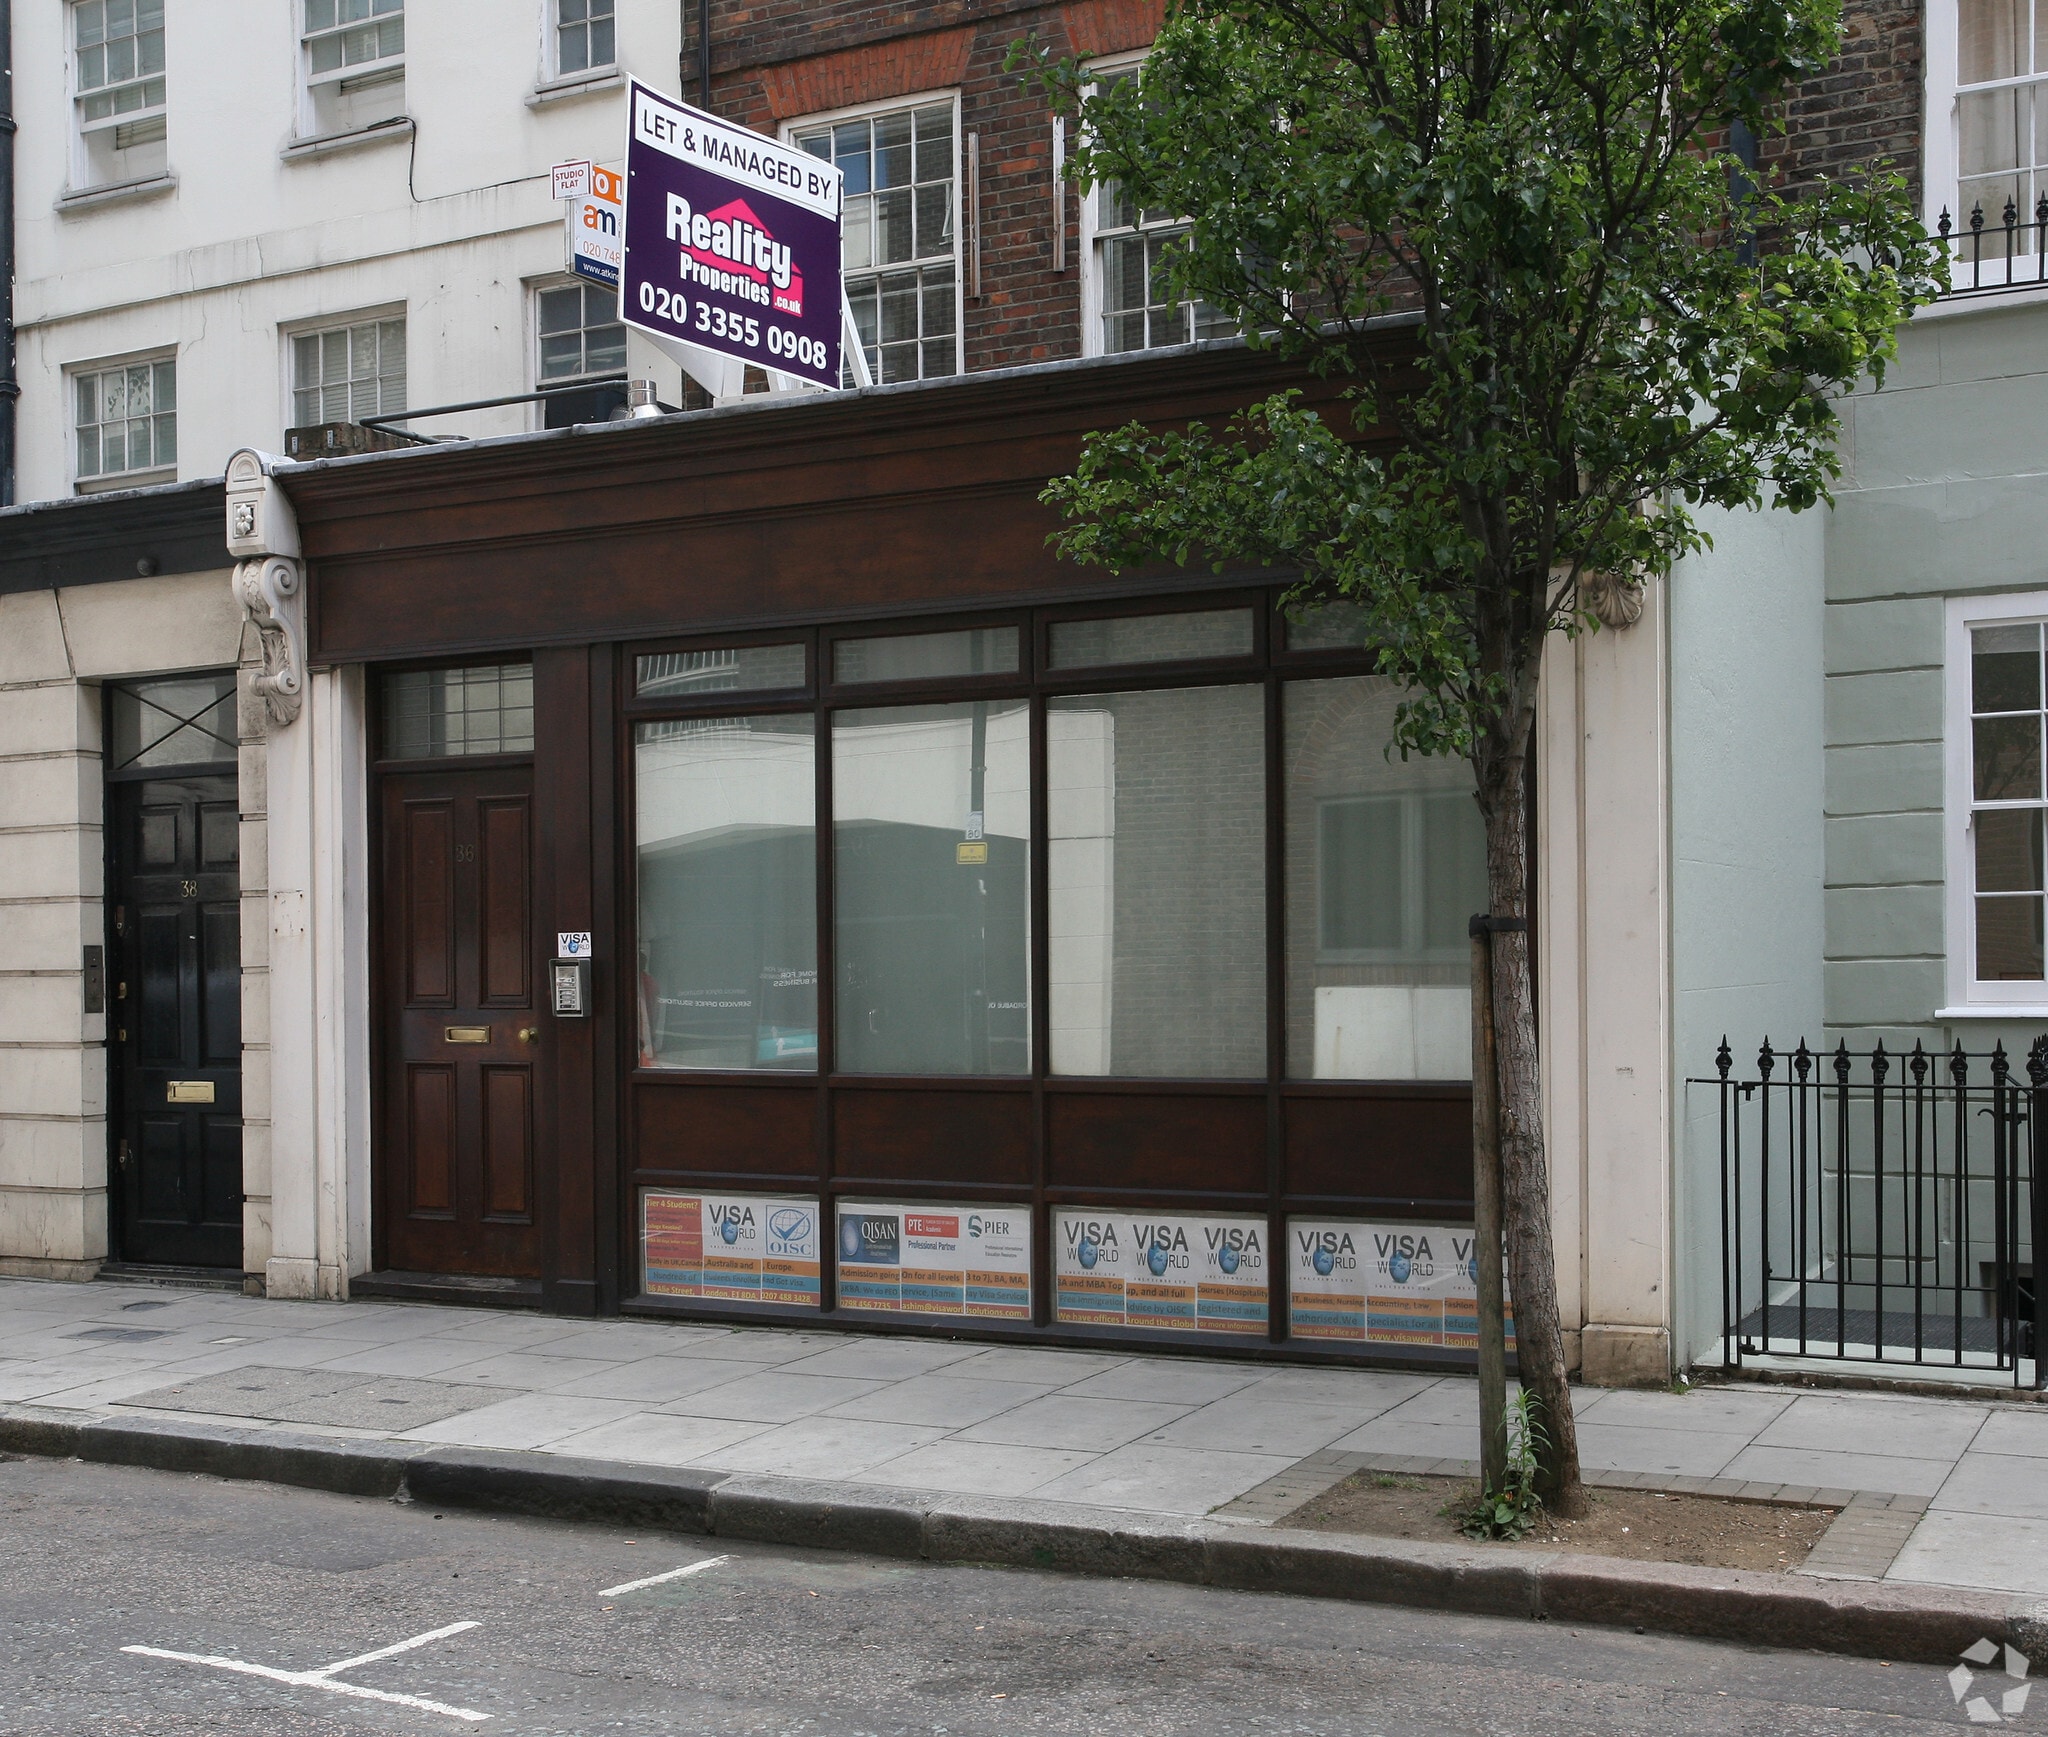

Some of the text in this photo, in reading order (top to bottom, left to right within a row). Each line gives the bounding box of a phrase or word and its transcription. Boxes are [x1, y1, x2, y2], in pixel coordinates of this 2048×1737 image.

[643, 109, 832, 200] LET & MANAGED BY
[555, 169, 585, 181] STUDIO
[561, 179, 580, 190] FLAT
[666, 191, 791, 290] Reality
[583, 241, 601, 258] 020
[679, 251, 770, 307] Properties
[774, 295, 802, 315] .co.uk
[639, 280, 827, 370] 020 3355 0908
[180, 879, 198, 898] 38
[560, 933, 590, 943] VISA
[666, 1200, 698, 1210] Student?
[709, 1204, 755, 1226] VISA
[861, 1221, 897, 1244] QISAN
[908, 1219, 922, 1232] PTE
[985, 1221, 1009, 1235] PIER
[1064, 1221, 1118, 1247] VISA
[908, 1240, 956, 1252] Professional Partner
[1133, 1224, 1188, 1252] VISA
[1204, 1227, 1261, 1253] VISA
[1298, 1231, 1356, 1255] VISA
[770, 1241, 812, 1256] OISC
[1374, 1234, 1433, 1261] VISA
[740, 1262, 754, 1270] and
[767, 1262, 794, 1272] Europe.
[841, 1269, 878, 1279] Admission
[914, 1271, 926, 1279] for
[927, 1272, 937, 1280] all
[938, 1273, 960, 1282] levels
[1069, 1280, 1084, 1288] and
[1108, 1282, 1123, 1291] Top
[1141, 1288, 1157, 1297] and
[1158, 1289, 1169, 1297] all
[1171, 1290, 1186, 1298] full
[1154, 1304, 1165, 1315] by
[1244, 1307, 1262, 1316] and
[1073, 1313, 1092, 1321] have
[1093, 1314, 1120, 1323] offices
[1156, 1318, 1169, 1326] the
[1411, 1319, 1424, 1328] for
